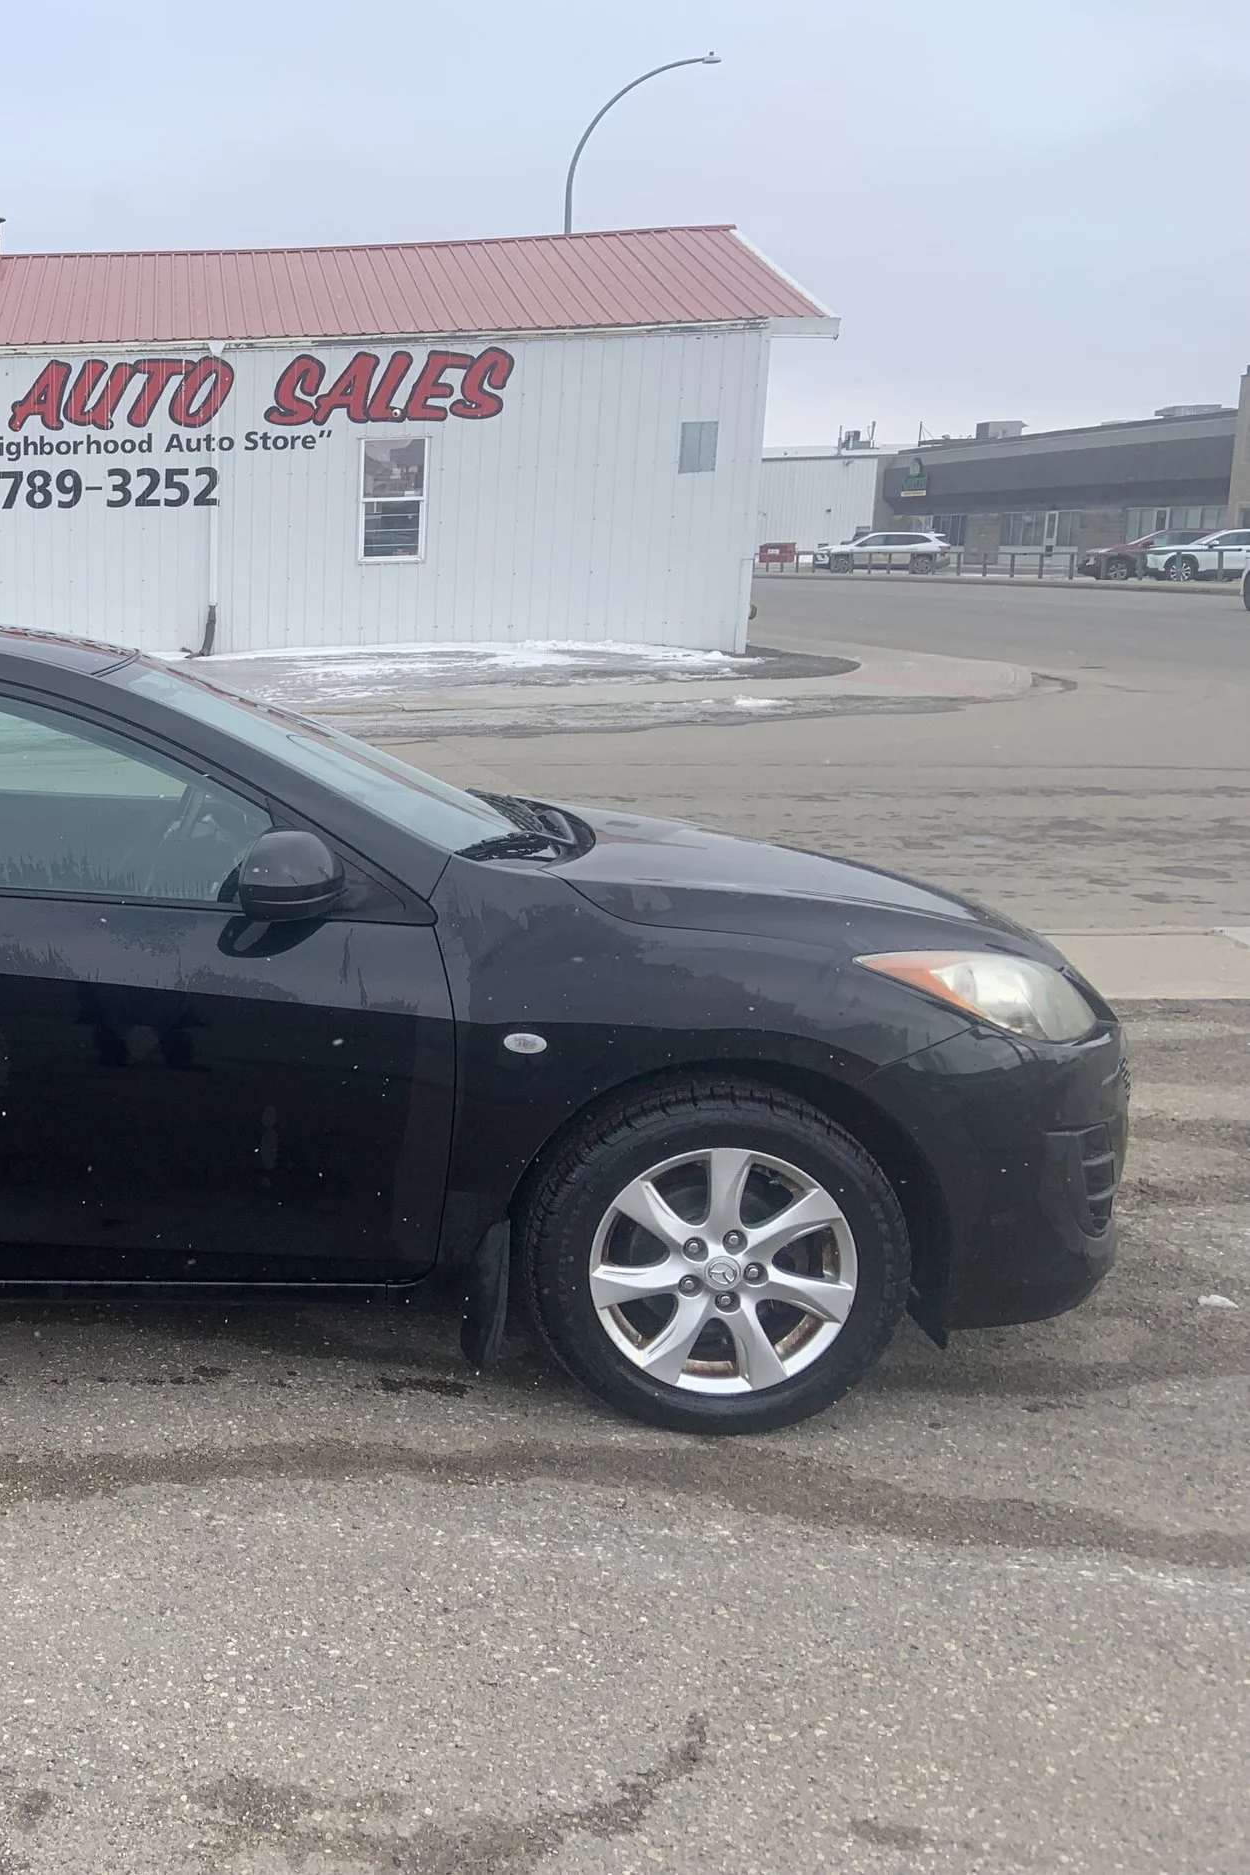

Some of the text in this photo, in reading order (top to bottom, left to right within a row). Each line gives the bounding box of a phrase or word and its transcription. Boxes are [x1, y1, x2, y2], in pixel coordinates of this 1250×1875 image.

[8, 356, 235, 431] AUTO
[264, 346, 515, 426] SALES
[164, 433, 235, 453] Auto
